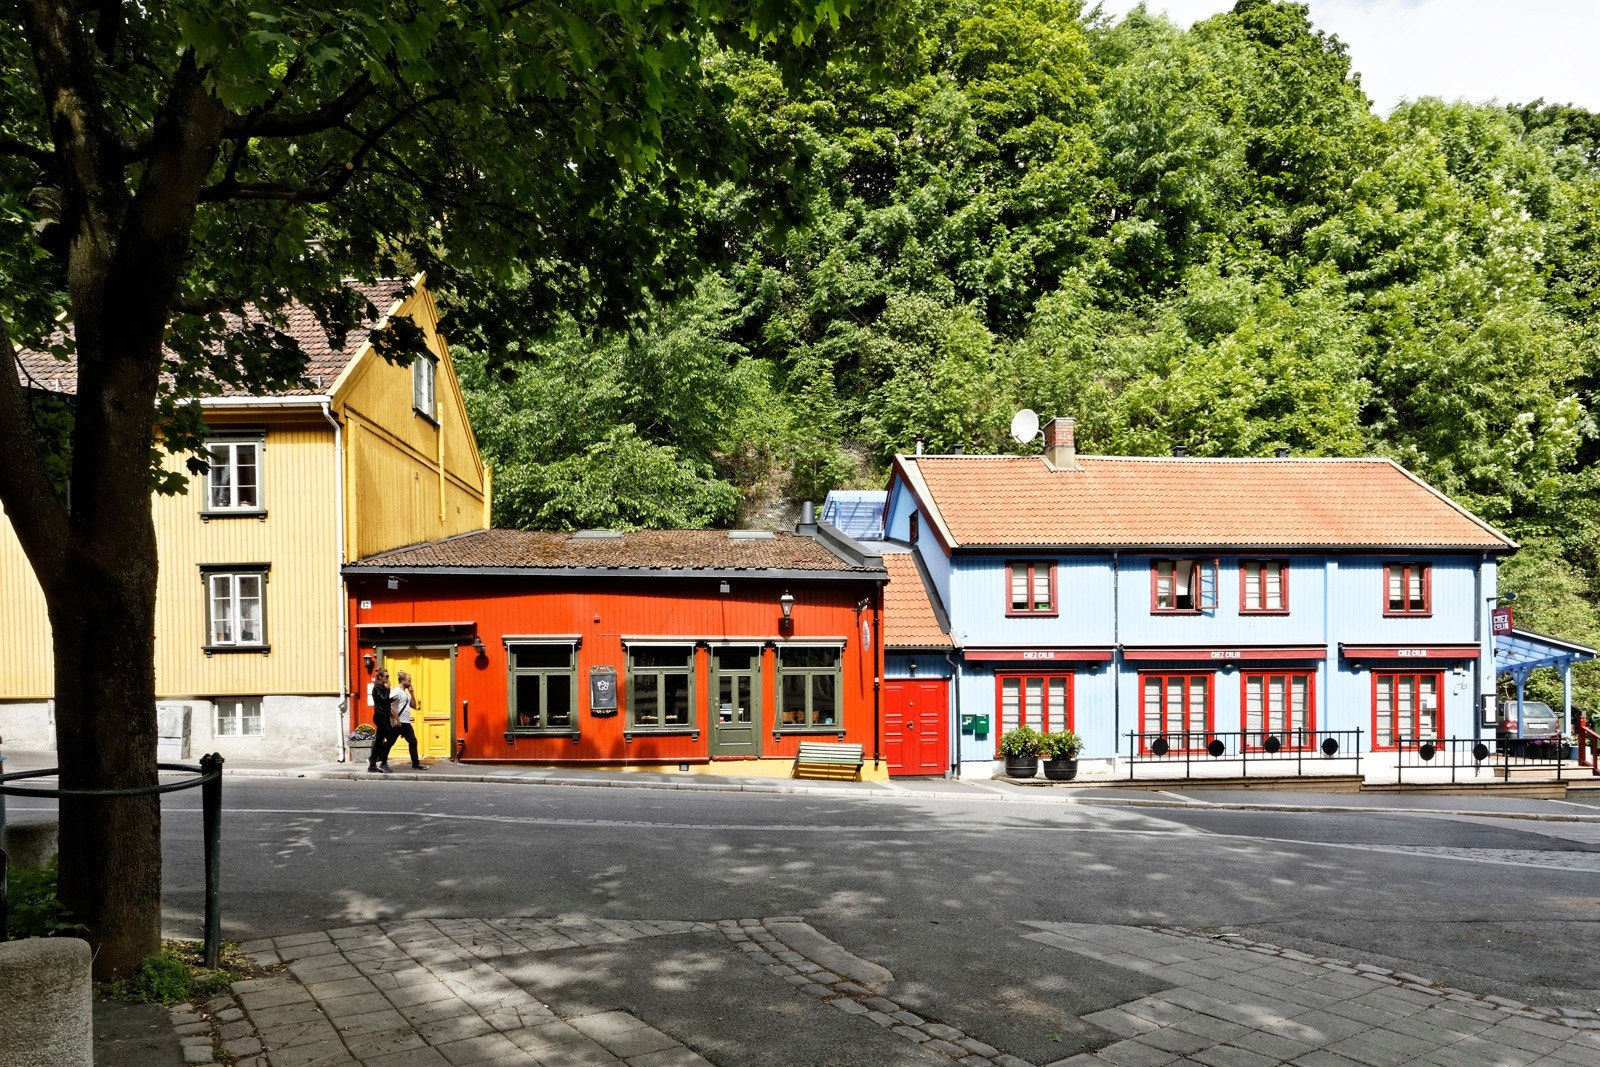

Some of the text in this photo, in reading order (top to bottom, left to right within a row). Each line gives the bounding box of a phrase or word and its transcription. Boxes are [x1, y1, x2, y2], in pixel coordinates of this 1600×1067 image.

[1494, 615, 1508, 623] CHEZ
[1494, 622, 1509, 630] COLIN
[1023, 651, 1054, 659] CHEZ COLIN
[1211, 651, 1240, 659] CHEZ COLIN
[1398, 649, 1426, 657] CHEZ COLIN
